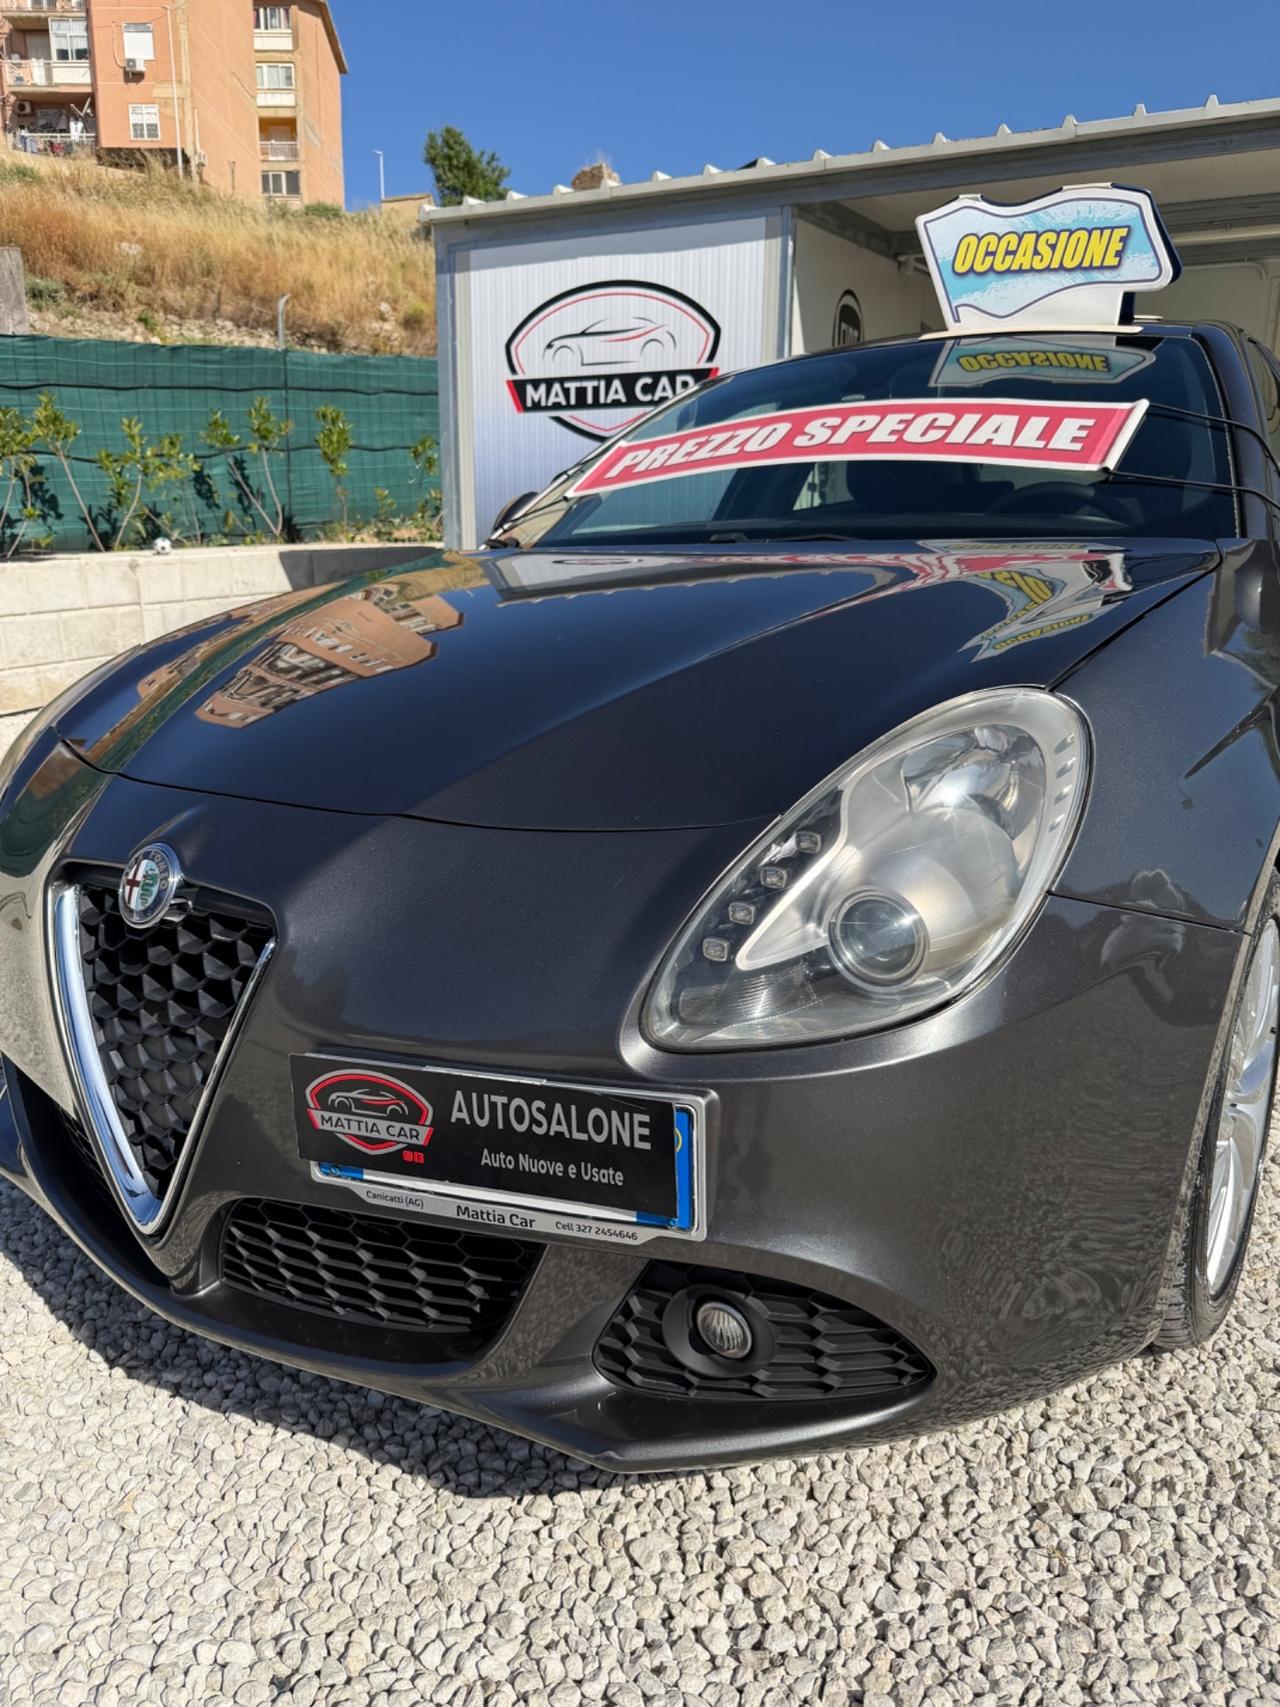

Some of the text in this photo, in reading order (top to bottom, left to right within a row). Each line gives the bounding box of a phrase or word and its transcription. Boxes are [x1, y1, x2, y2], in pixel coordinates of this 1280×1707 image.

[953, 226, 1130, 275] OCCASIONE
[525, 379, 627, 408] MATTIA
[603, 412, 1096, 479] PREZZO SPECIALE
[319, 1114, 421, 1141] MATTIA CAR
[450, 1090, 652, 1151] AUTOSALONE
[481, 1148, 625, 1186] Auto Nuove e Usate
[405, 1196, 424, 1210] (AG)
[456, 1205, 536, 1229] Mattia Car
[555, 1221, 638, 1241] Cell 327 2454646
